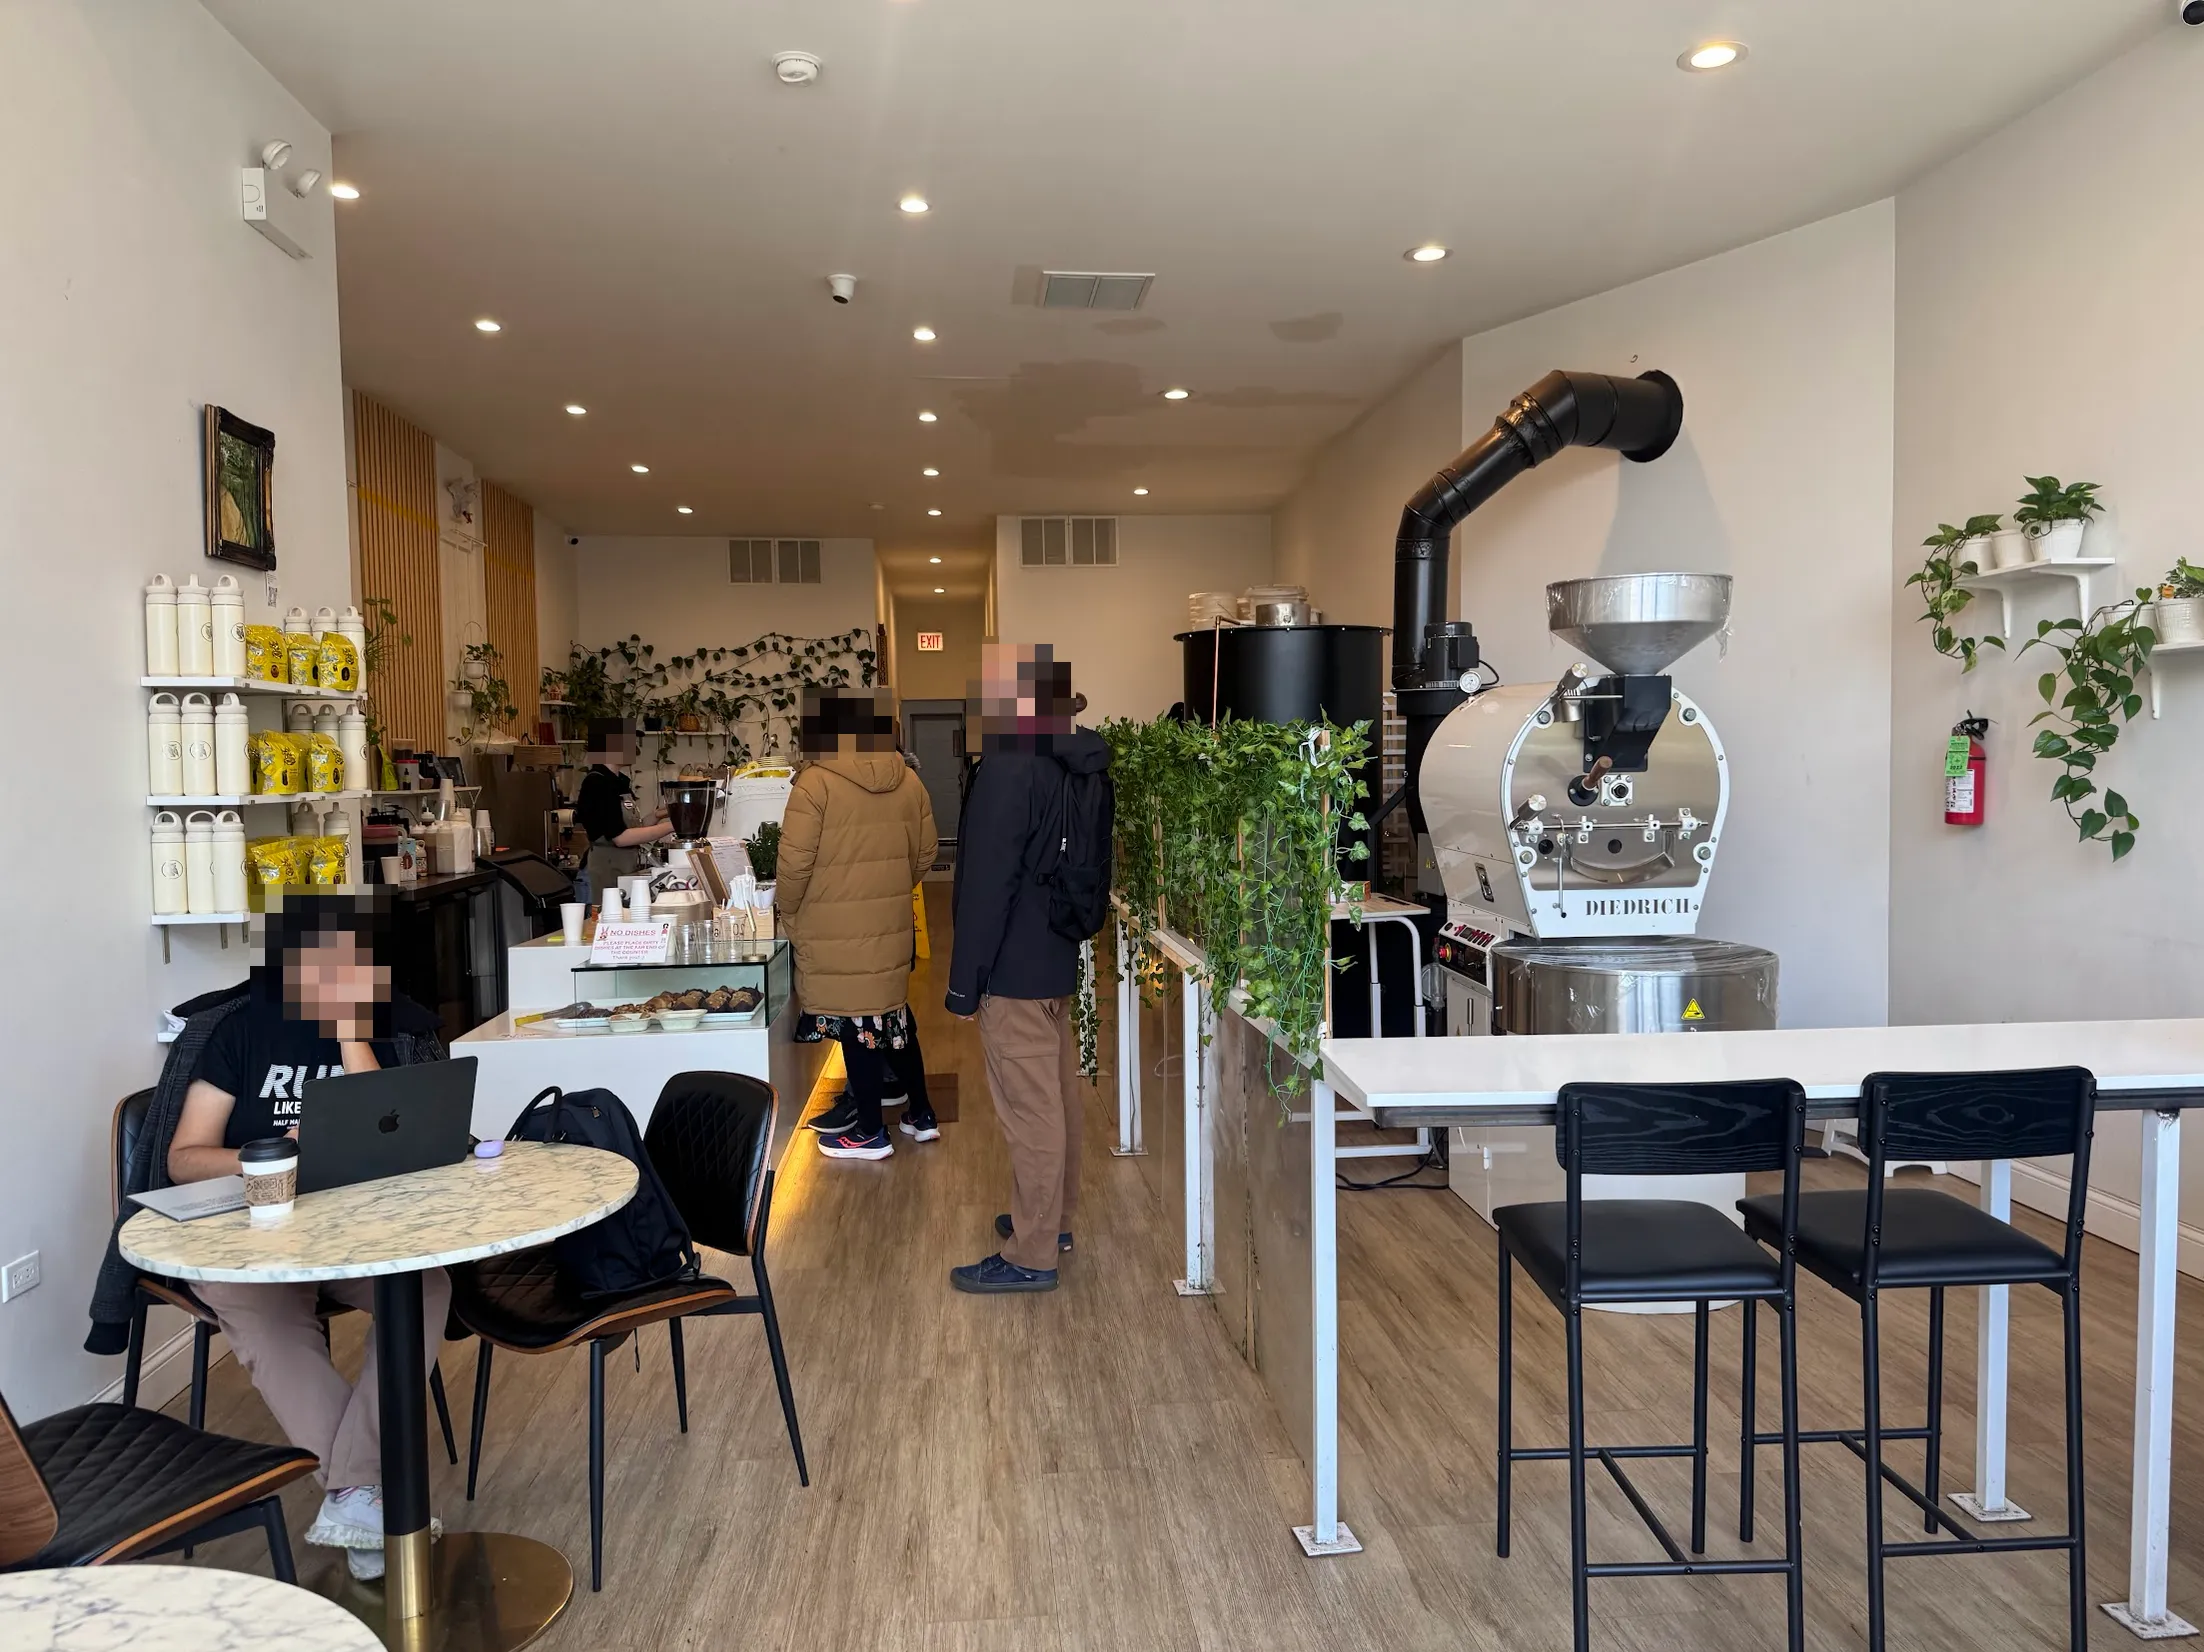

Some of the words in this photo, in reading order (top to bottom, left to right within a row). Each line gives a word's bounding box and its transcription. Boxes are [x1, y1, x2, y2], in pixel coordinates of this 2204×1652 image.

[920, 635, 941, 649] EXIT
[1586, 898, 1690, 916] DIEDRICH
[273, 1101, 302, 1115] LIKE
[273, 1119, 289, 1127] HALF
